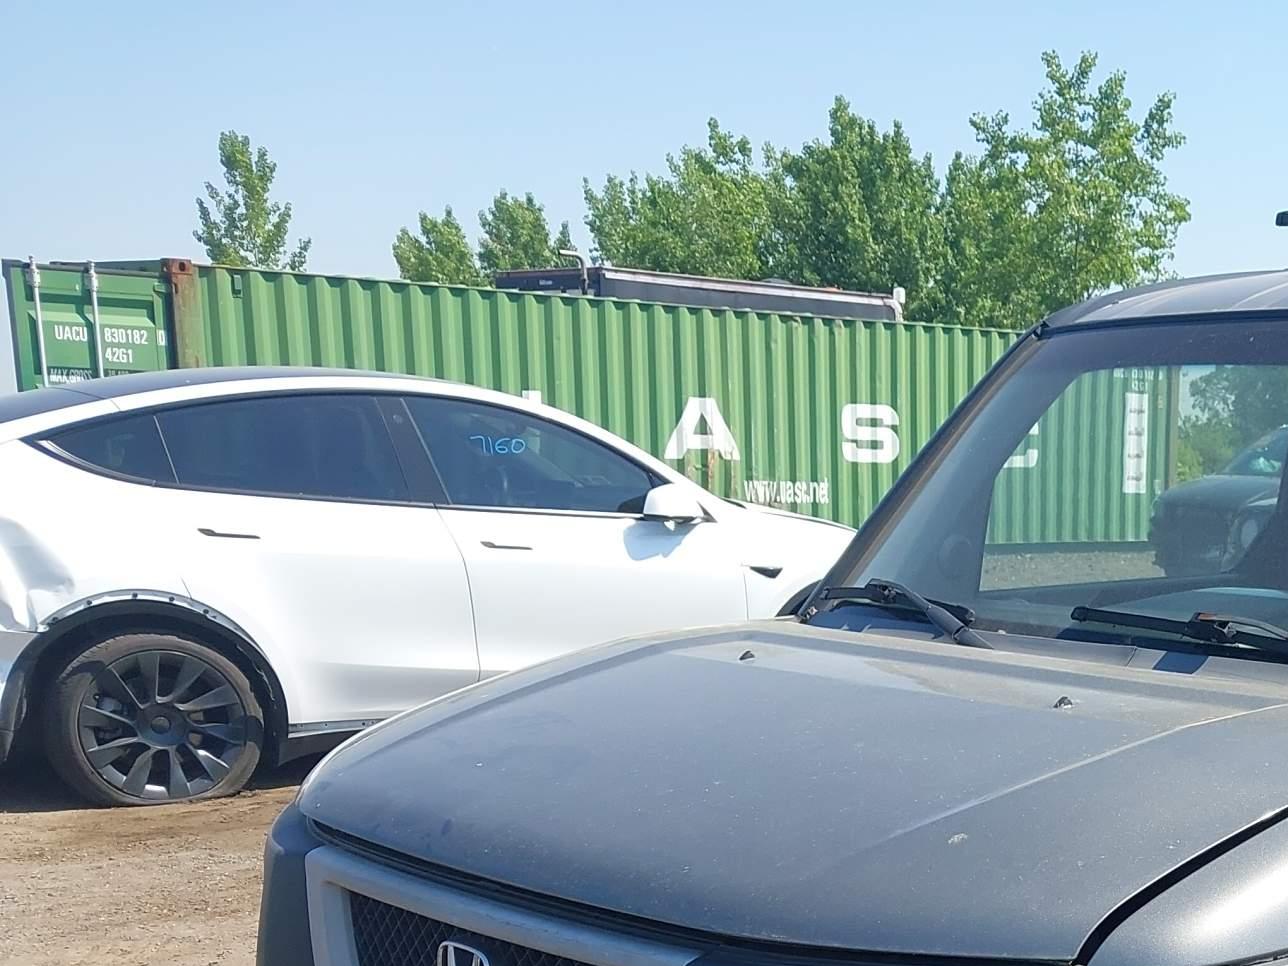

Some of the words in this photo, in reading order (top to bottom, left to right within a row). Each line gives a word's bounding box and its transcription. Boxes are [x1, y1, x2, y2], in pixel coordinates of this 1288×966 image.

[55, 325, 88, 341] UACU
[104, 328, 148, 344] 830182
[105, 347, 133, 363] 42G1
[664, 397, 740, 461] A
[841, 403, 900, 463] S
[469, 435, 526, 455] 7160
[744, 477, 830, 504] www.uasc.net
